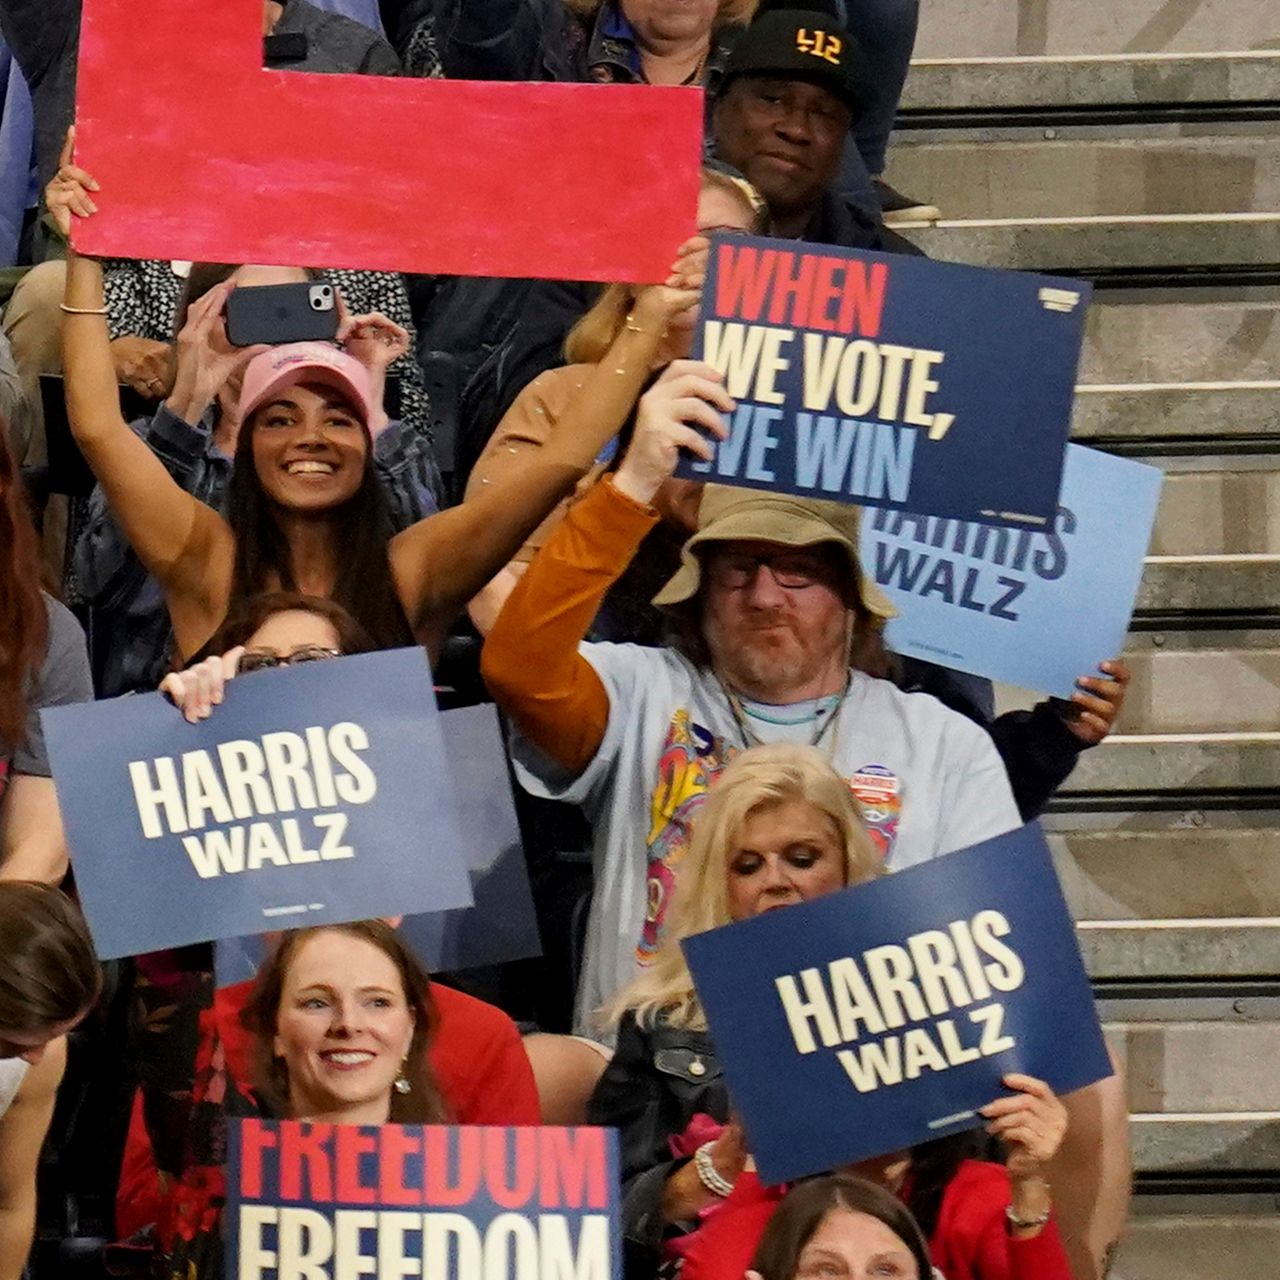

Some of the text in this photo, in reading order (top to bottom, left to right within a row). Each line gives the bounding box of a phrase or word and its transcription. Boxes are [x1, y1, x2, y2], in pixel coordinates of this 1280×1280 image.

[797, 28, 840, 64] 412
[715, 245, 888, 337] WHEN
[703, 320, 956, 441] WE VOTE,
[796, 413, 916, 502] WIN
[873, 542, 1027, 622] WALZ
[129, 721, 377, 840] HARRIS
[182, 813, 354, 879] WALZ
[776, 910, 1023, 1056] HARRIS
[837, 1002, 1016, 1093] WALZ
[243, 1119, 607, 1210] FREEDOM
[238, 1204, 611, 1280] FREEDOM
